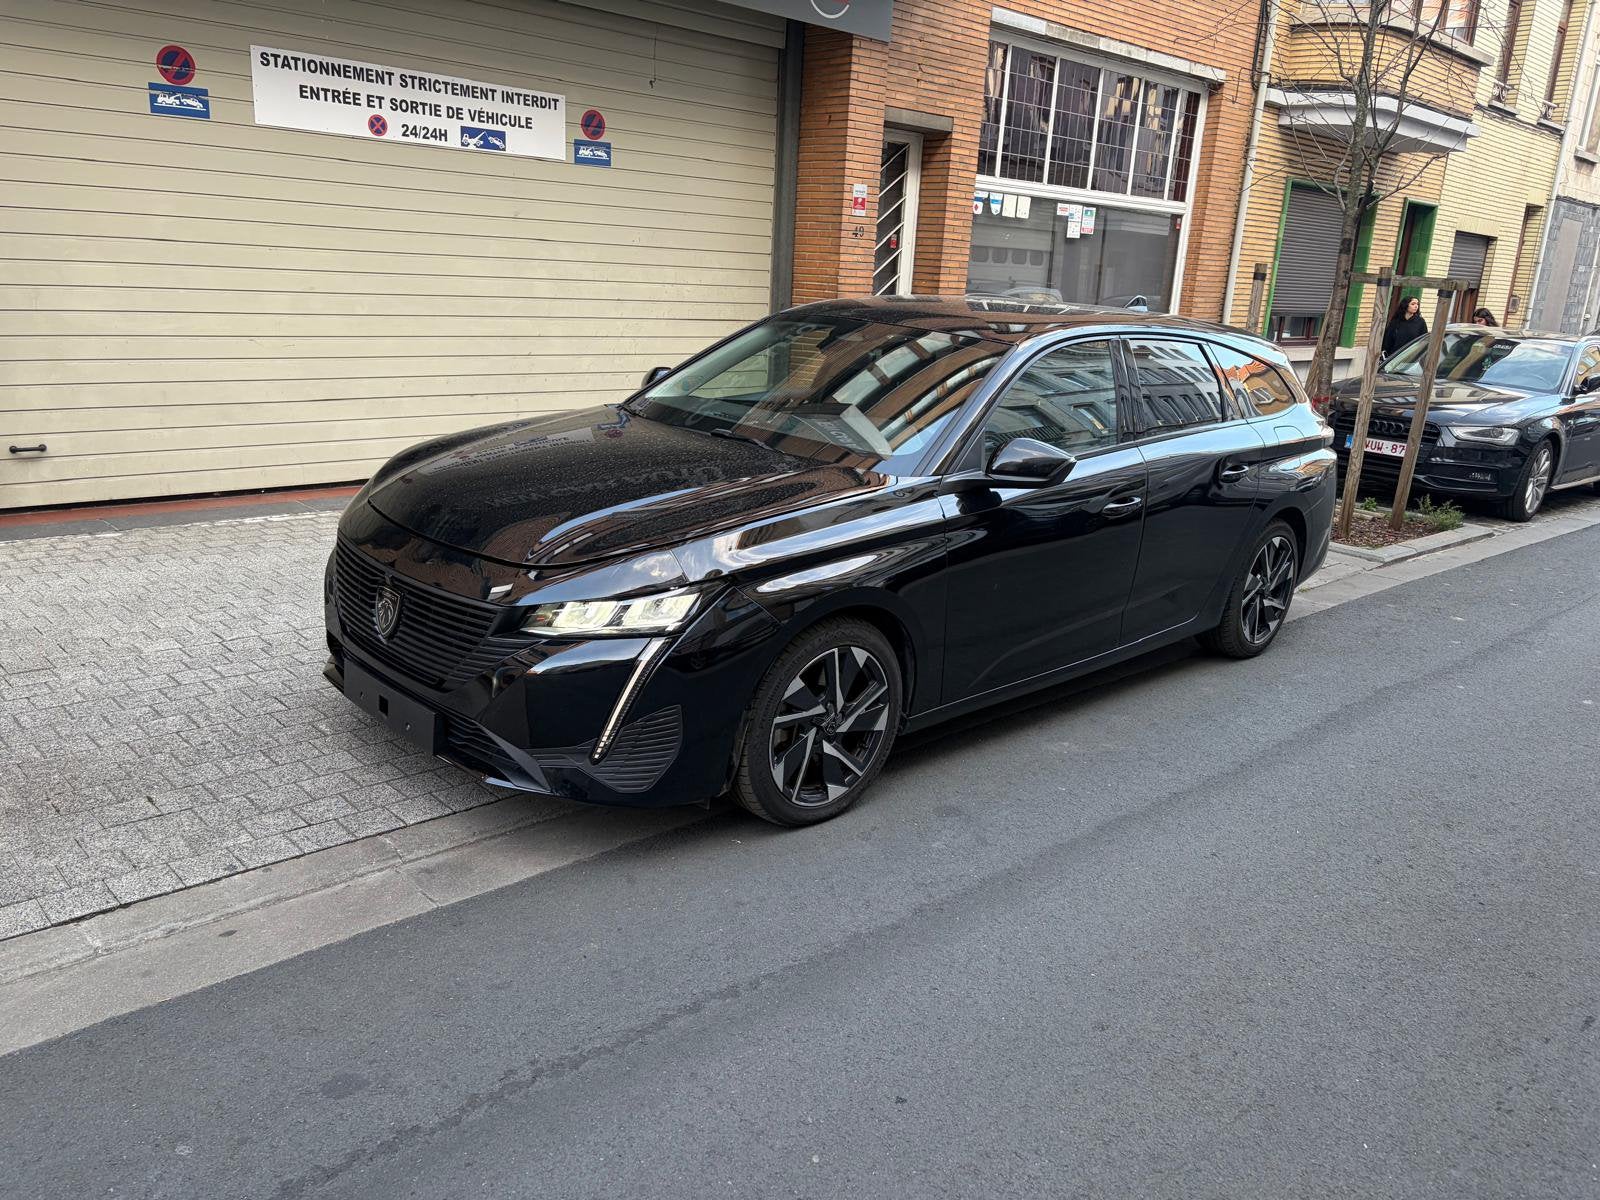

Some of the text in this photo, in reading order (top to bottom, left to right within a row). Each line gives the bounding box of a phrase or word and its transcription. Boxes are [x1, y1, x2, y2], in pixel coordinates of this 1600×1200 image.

[260, 51, 559, 111] STATIONNEMENT STRICTEMENT INTERDIT
[299, 84, 533, 130] ENTRÉE ET SORTIE DE VÉHICULE
[401, 123, 448, 142] 24/24H
